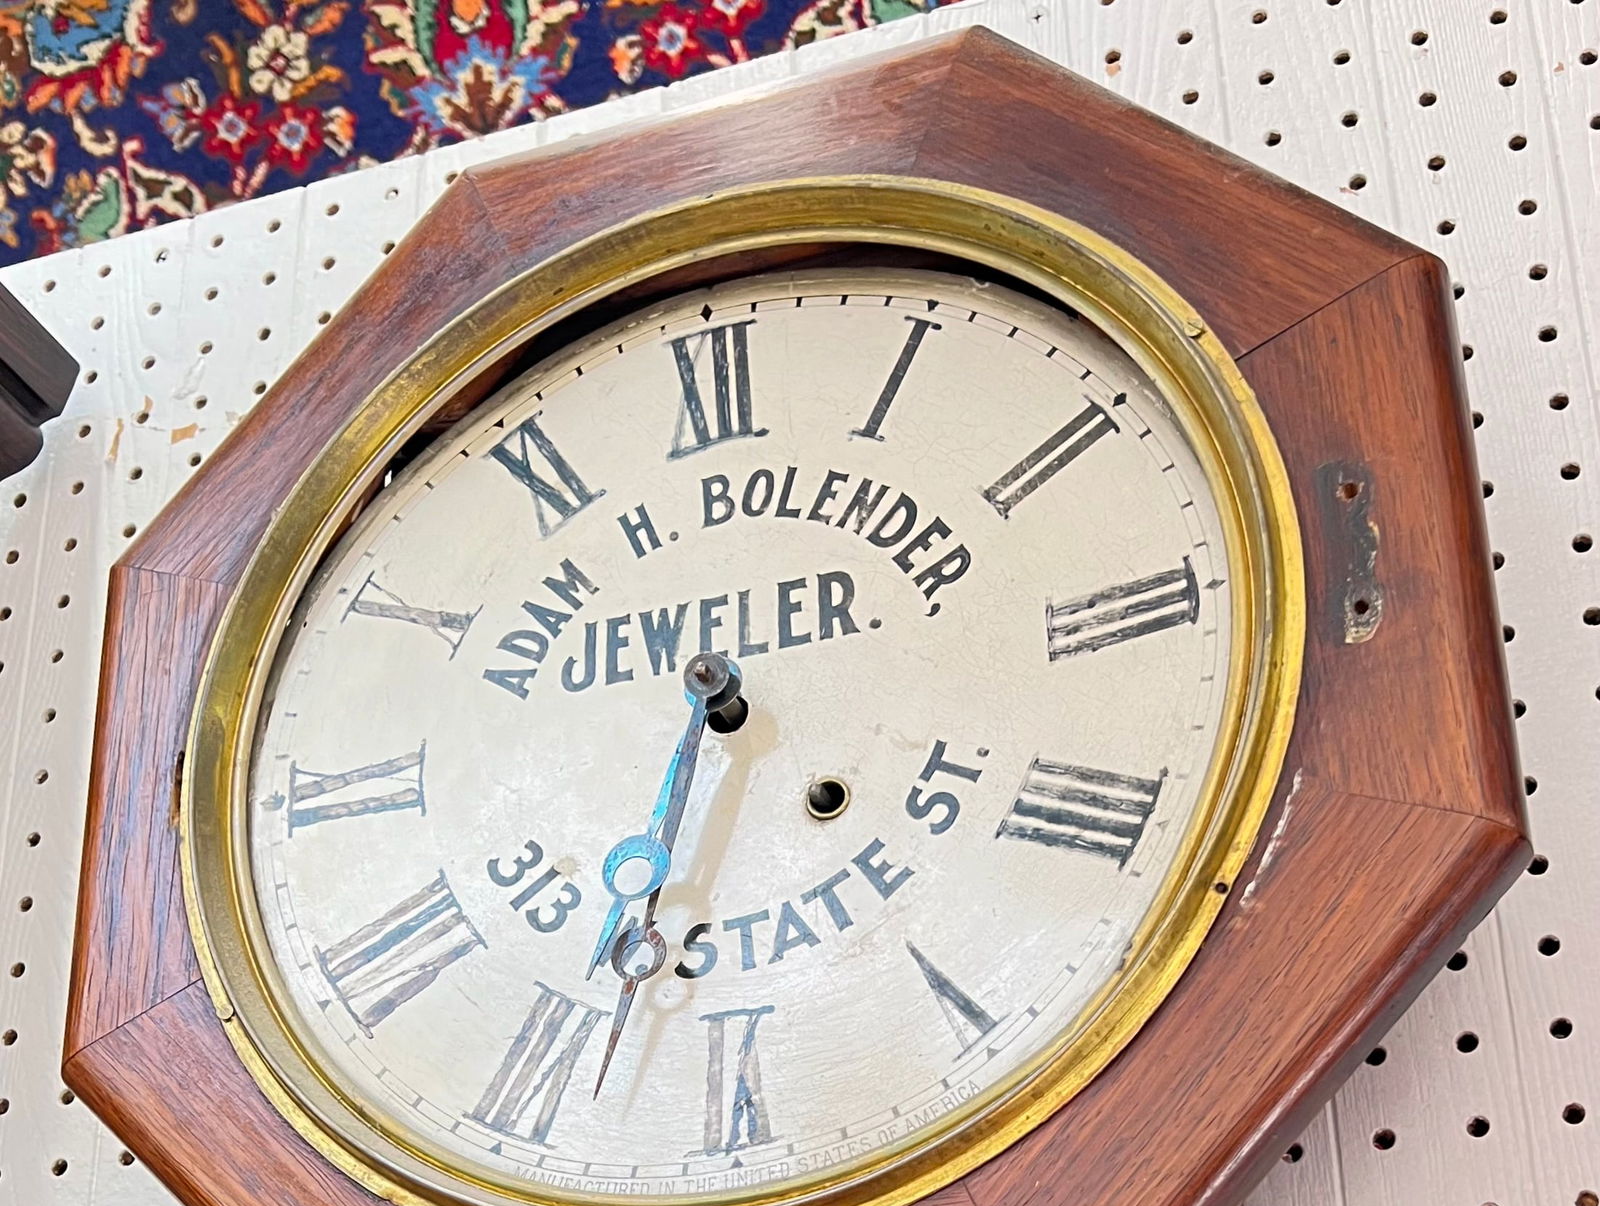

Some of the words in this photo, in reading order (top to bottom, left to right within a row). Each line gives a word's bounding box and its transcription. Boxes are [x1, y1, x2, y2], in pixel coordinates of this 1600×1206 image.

[664, 318, 769, 461] XII
[848, 315, 942, 442] I
[483, 410, 606, 540] XI
[977, 393, 1121, 519] II
[340, 570, 484, 661] X
[482, 557, 600, 700] ADAM
[616, 502, 679, 559] H.
[700, 465, 971, 617] BOLENDER,
[561, 571, 882, 693] JEWELER.
[1046, 555, 1200, 662] III
[287, 738, 426, 838] IX
[995, 752, 1169, 871] IIII
[487, 839, 582, 933] 313
[674, 837, 915, 979] STATE
[905, 739, 989, 836] ST.
[513, 1166, 650, 1196] MANUFACTURED
[658, 1180, 676, 1195] IN
[684, 1175, 716, 1194] THE
[724, 1162, 790, 1187] UNITED
[799, 1137, 873, 1175] STATES
[878, 1126, 900, 1148] OF
[905, 1078, 981, 1134] AMERICA
